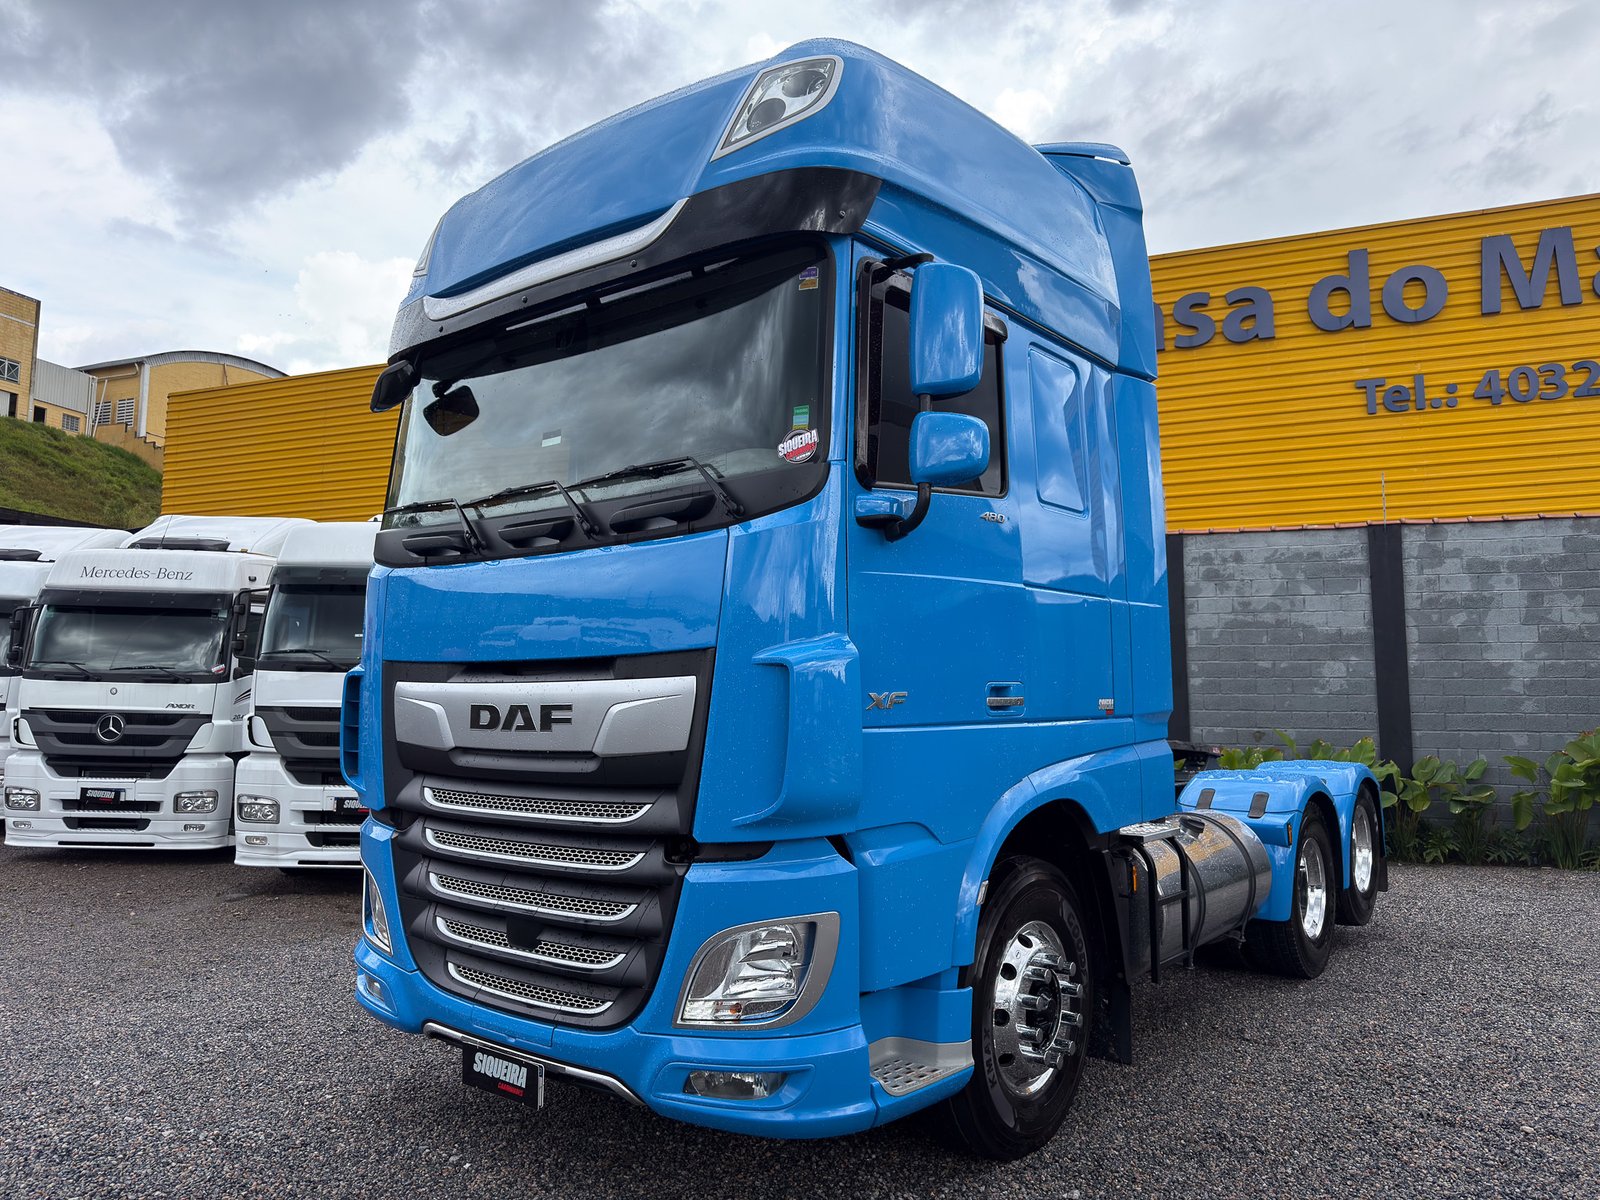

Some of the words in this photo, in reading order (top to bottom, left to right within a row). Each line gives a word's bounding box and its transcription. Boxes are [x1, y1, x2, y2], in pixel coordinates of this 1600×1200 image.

[1307, 248, 1449, 333] do
[1481, 226, 1600, 316] M
[1355, 373, 1458, 415] Tel.:
[1473, 360, 1600, 405] 4032
[777, 429, 818, 457] SIQUEIRA
[980, 511, 1005, 524] 480
[80, 566, 193, 581] Mercedes-Benz
[866, 691, 908, 710] XF
[469, 703, 573, 733] DAF
[86, 790, 115, 799] SIQUEIRA
[473, 1052, 528, 1088] SIQUEIRA
[984, 1027, 997, 1089] KMAX
